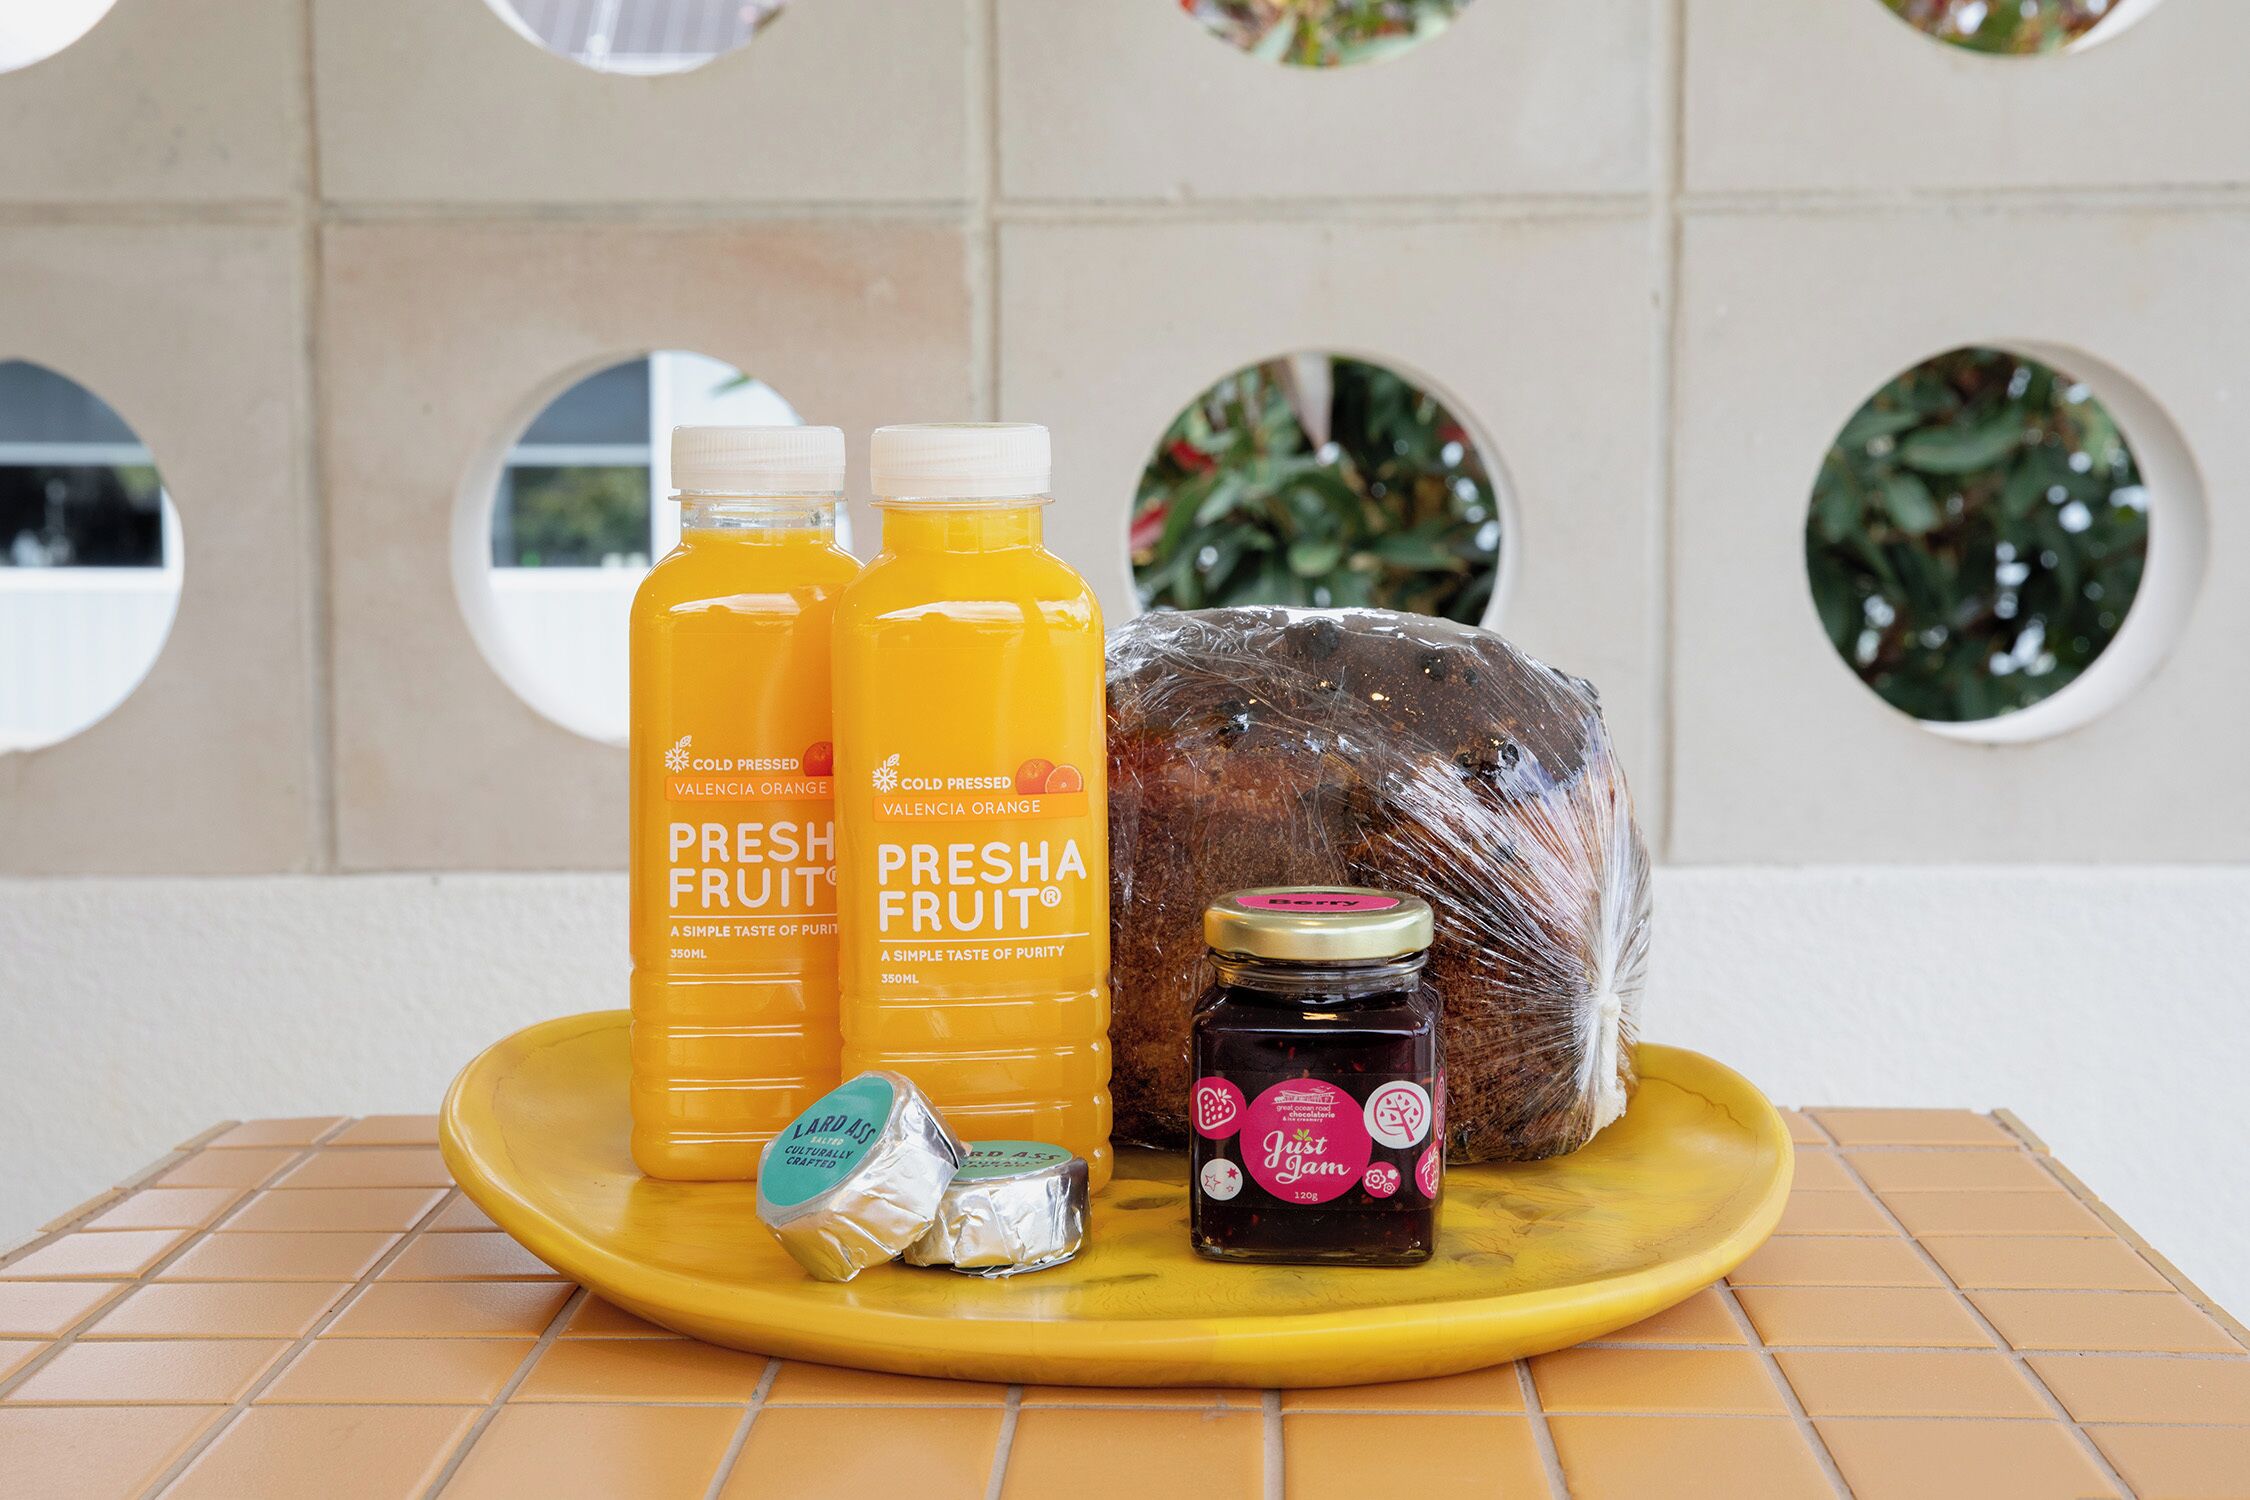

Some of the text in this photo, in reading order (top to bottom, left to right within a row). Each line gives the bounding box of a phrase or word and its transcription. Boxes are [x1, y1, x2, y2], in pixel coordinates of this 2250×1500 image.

[692, 757, 799, 771] COLD PRESSED
[674, 781, 828, 796] VALENCIA ORANGE
[901, 775, 1012, 791] COLD PRESSED
[882, 799, 1041, 816] VALENCIA ORANGE
[669, 821, 835, 863] PRESH
[877, 838, 1087, 886] PRESHA
[1268, 898, 1360, 906] Berry
[670, 923, 838, 938] A SIMPLE TASTE OF PURIT
[670, 948, 707, 959] 350ML
[881, 945, 1065, 962] A SIMPLE TASTE OF PURITY
[881, 973, 919, 984] 350ML
[1276, 1104, 1294, 1112] great
[1289, 1110, 1336, 1118] chocolaterie
[792, 1114, 876, 1145] LARD ASS
[810, 1136, 845, 1146] SALTED
[784, 1145, 854, 1160] CULTURALLY
[968, 1150, 1004, 1158] RD
[1011, 1151, 1062, 1161] ASS
[1262, 1130, 1328, 1169] Just
[786, 1156, 836, 1169] CRAFTED
[1275, 1154, 1351, 1185] Jam
[1294, 1191, 1318, 1201] 120g
